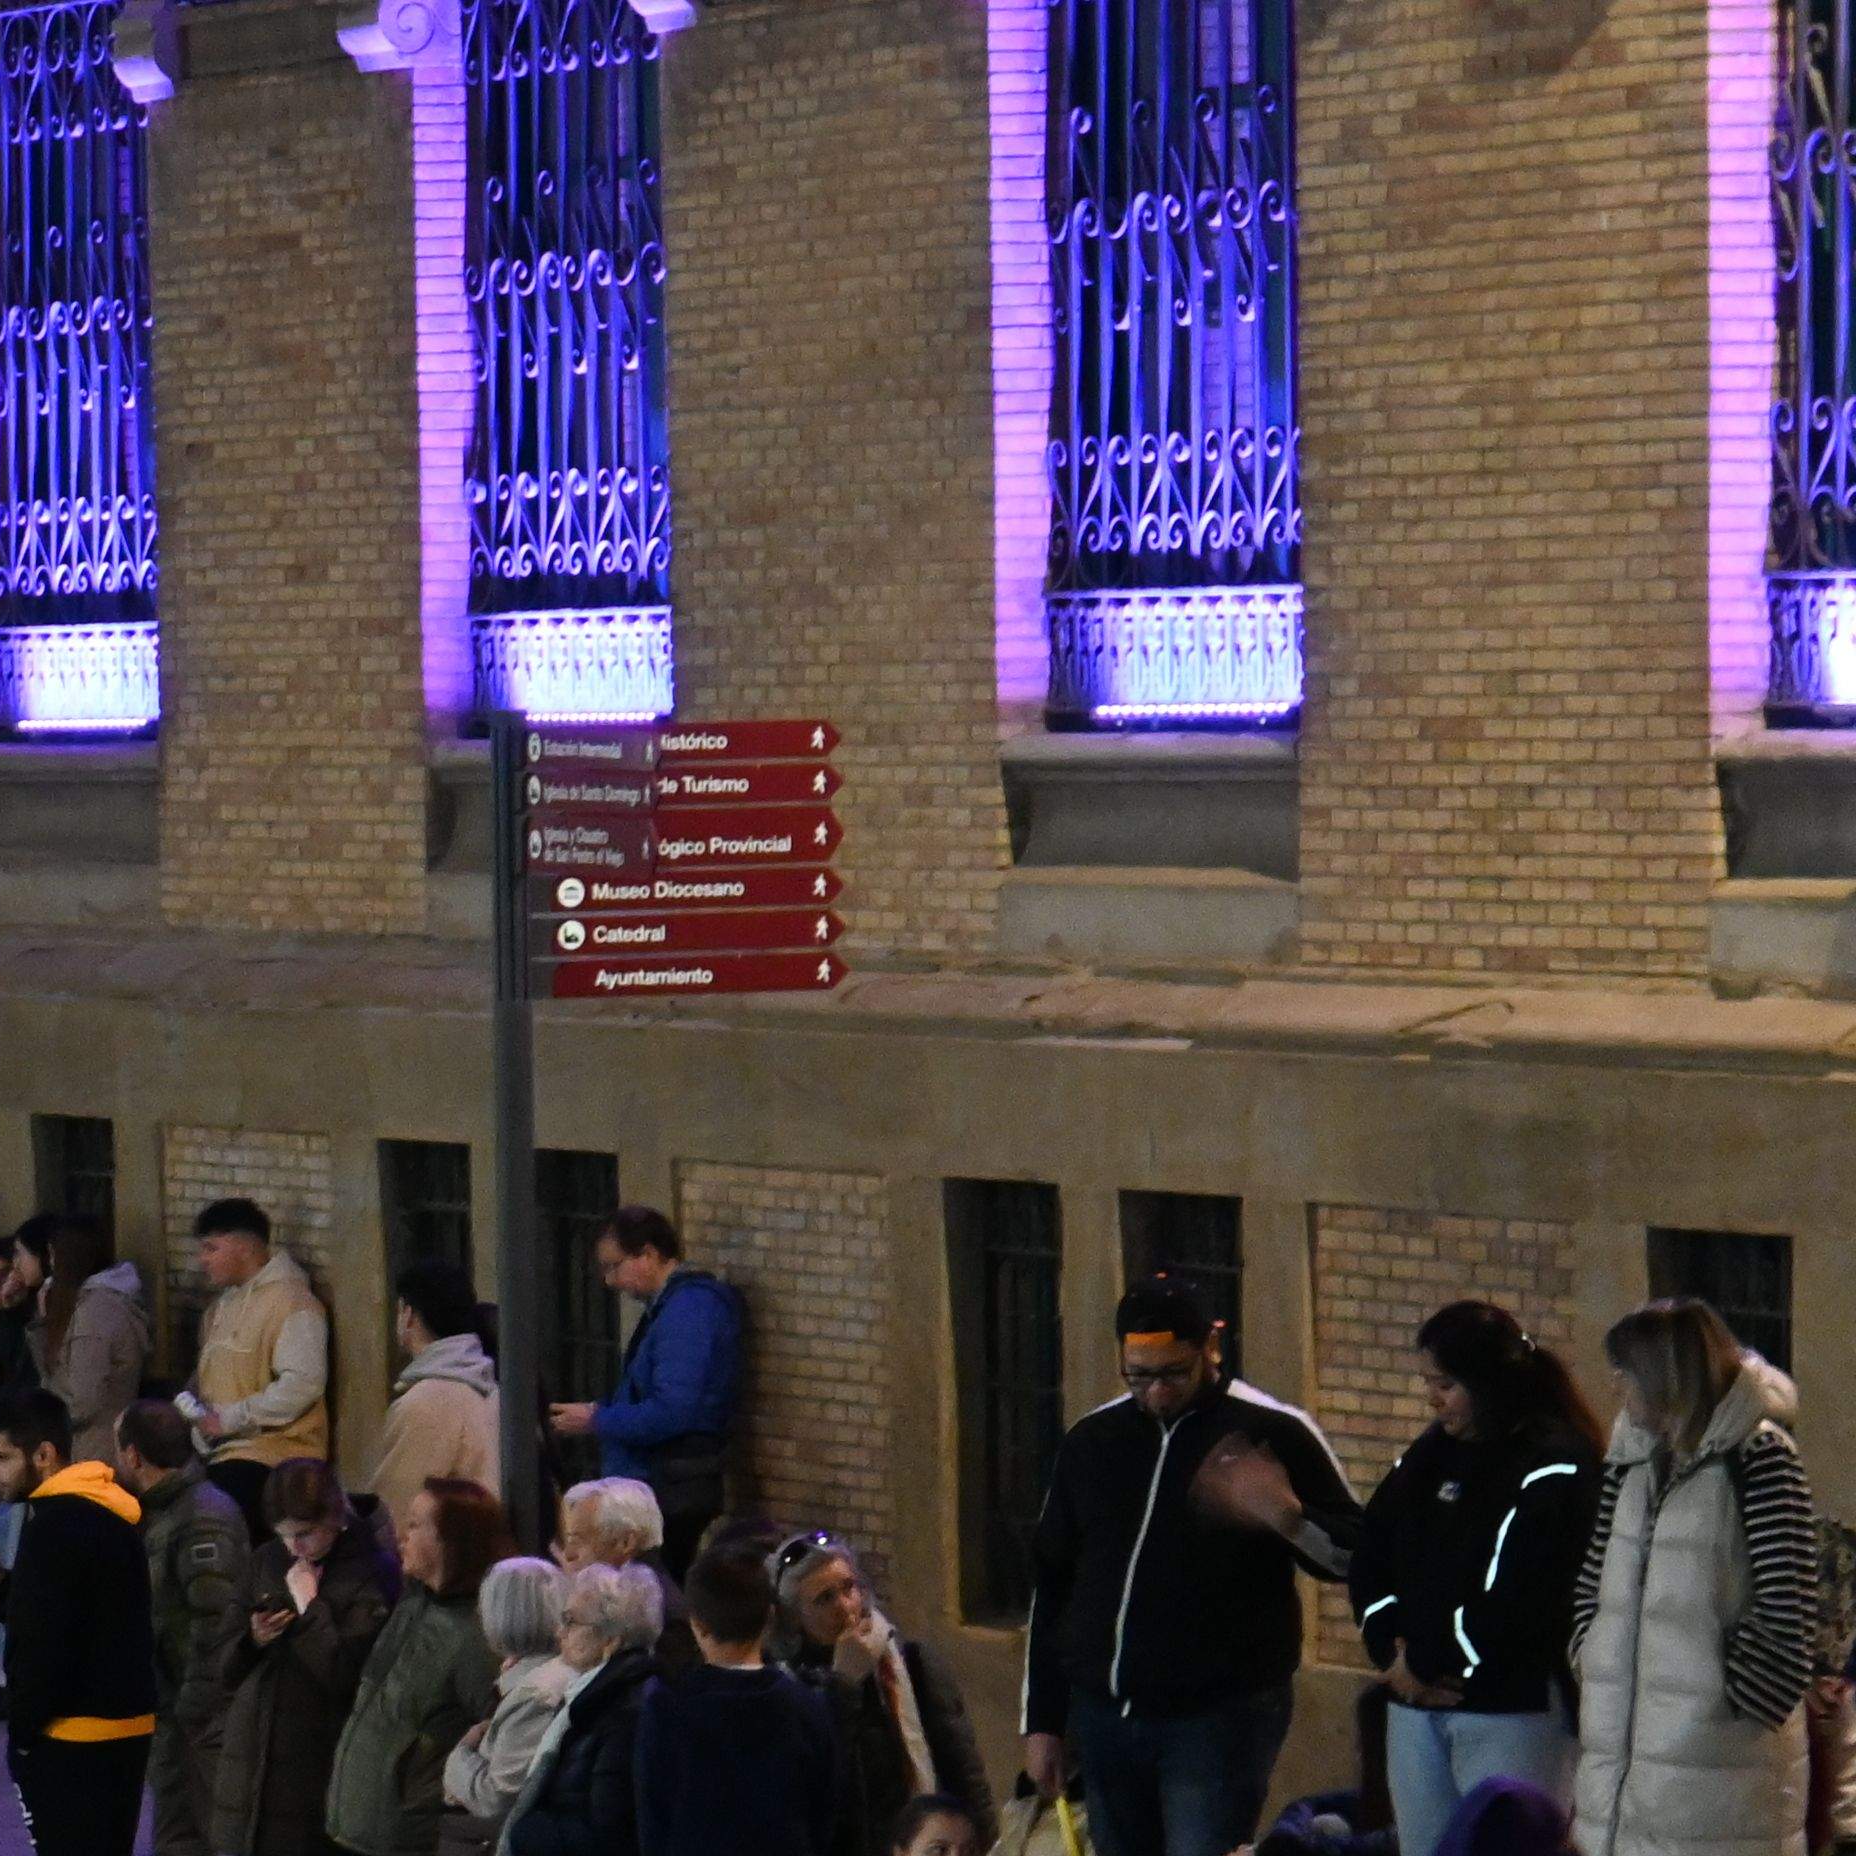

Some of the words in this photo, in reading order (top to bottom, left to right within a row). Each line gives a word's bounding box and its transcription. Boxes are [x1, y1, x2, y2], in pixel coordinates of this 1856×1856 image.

[682, 775, 749, 794] Turismo
[709, 836, 792, 855] Provincial
[592, 881, 649, 901] Museo
[655, 879, 746, 899] Diocesano
[593, 924, 667, 944] Catedral
[595, 968, 714, 991] Ayuntamiento
